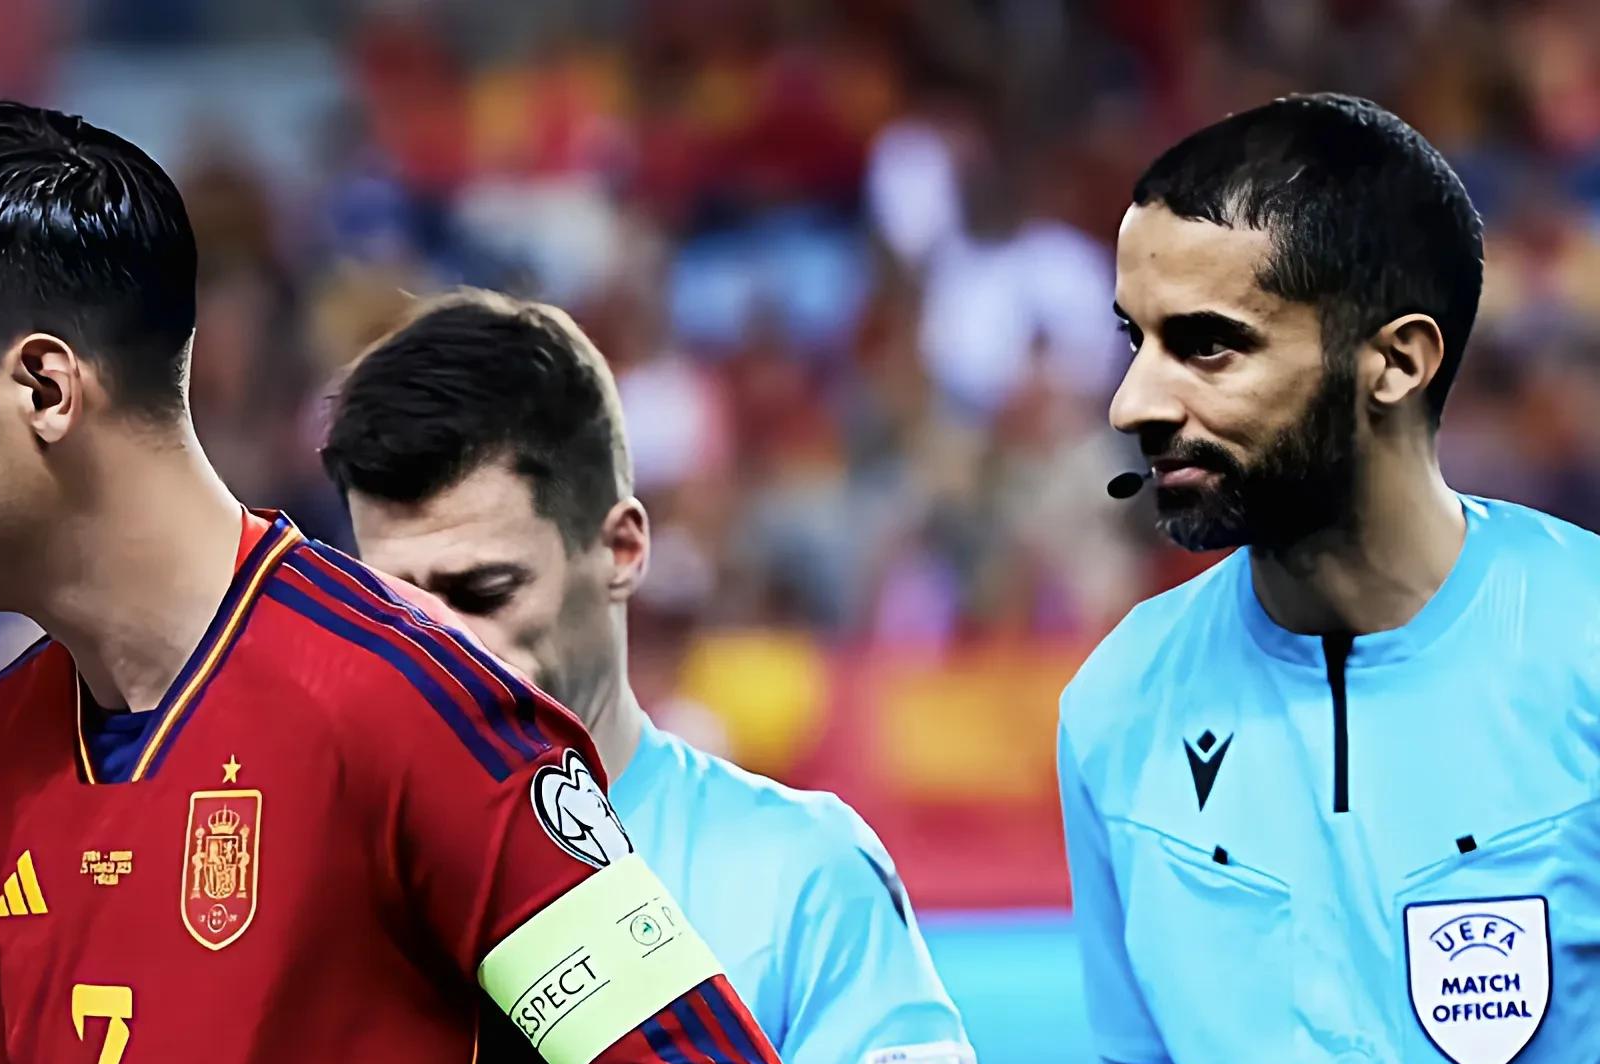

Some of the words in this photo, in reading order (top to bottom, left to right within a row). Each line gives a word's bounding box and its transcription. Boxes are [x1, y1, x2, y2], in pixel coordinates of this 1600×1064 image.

[1434, 920, 1516, 952] UEFA
[515, 954, 597, 1040] ESPECT
[1441, 972, 1521, 996] MATCH
[1432, 999, 1533, 1023] OFFICIAL
